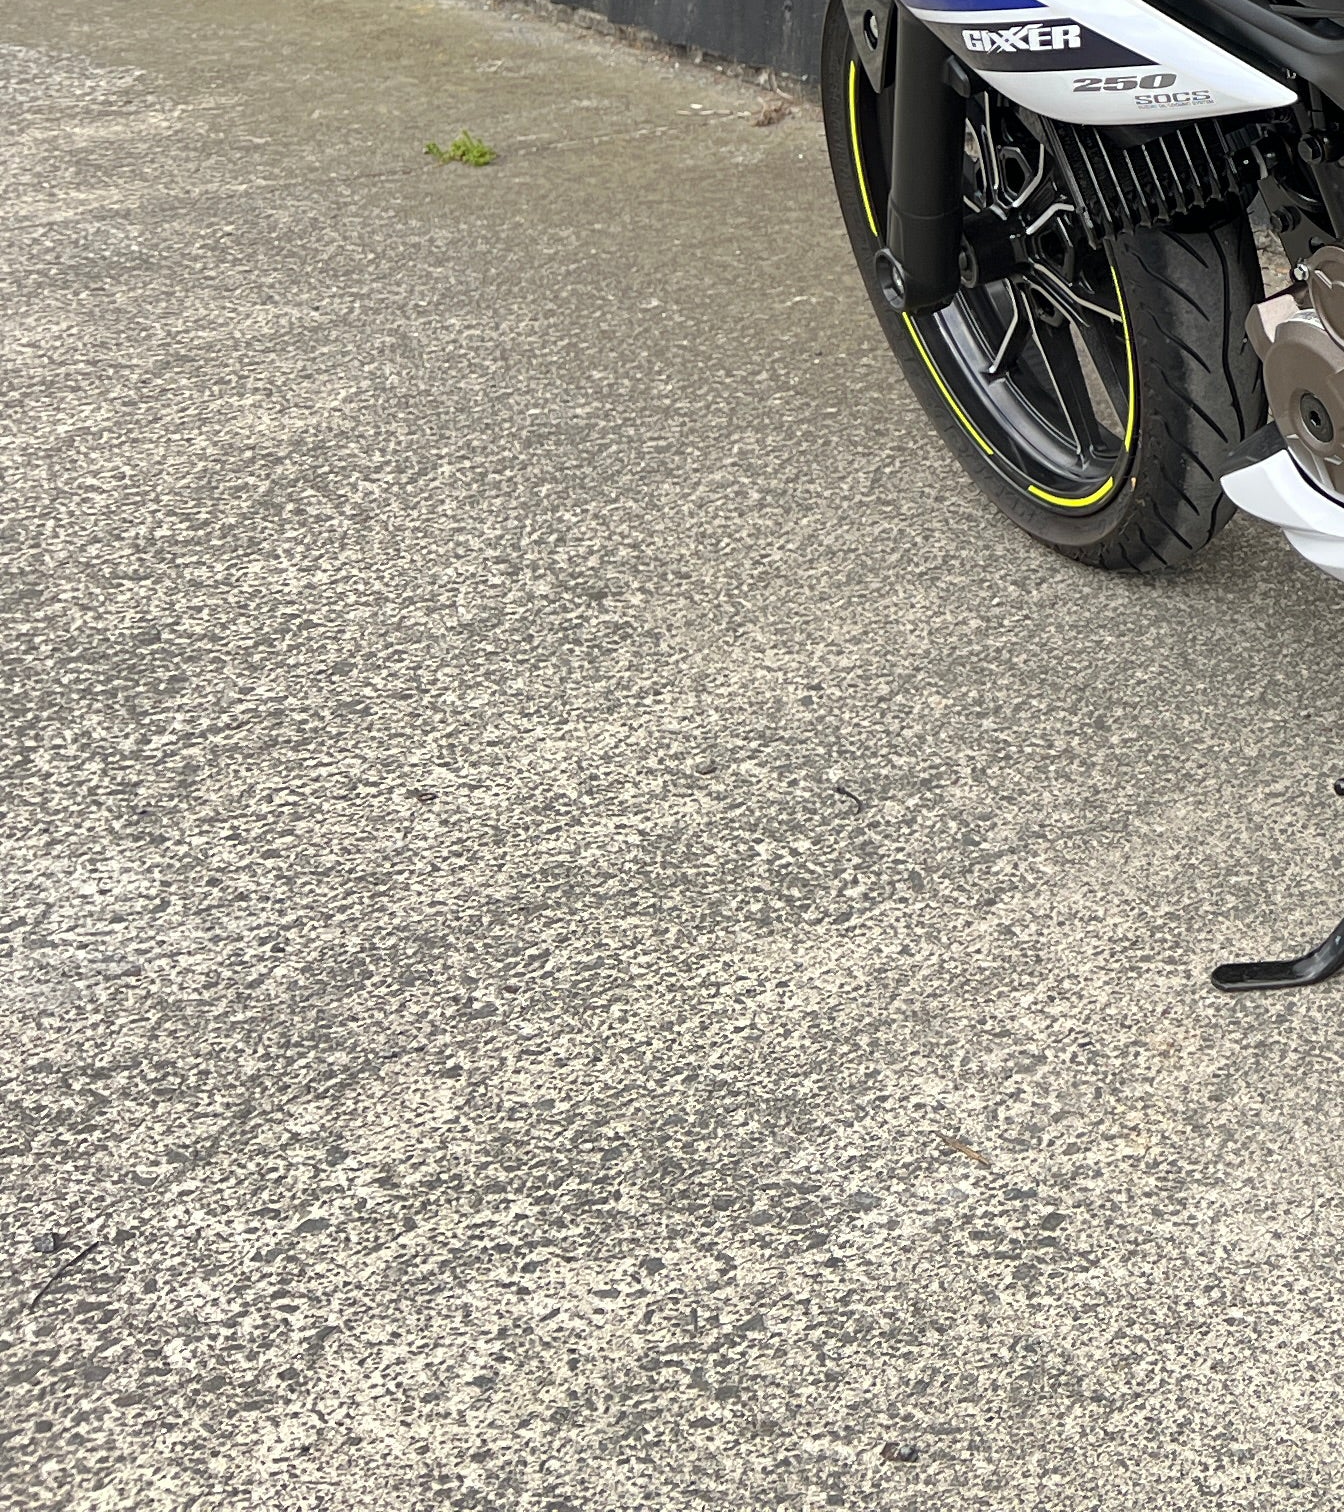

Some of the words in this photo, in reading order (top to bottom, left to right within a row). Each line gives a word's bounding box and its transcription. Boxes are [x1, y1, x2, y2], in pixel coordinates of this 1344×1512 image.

[961, 23, 1081, 54] GIXXER
[1072, 73, 1178, 93] 250
[1134, 89, 1211, 105] SOCS
